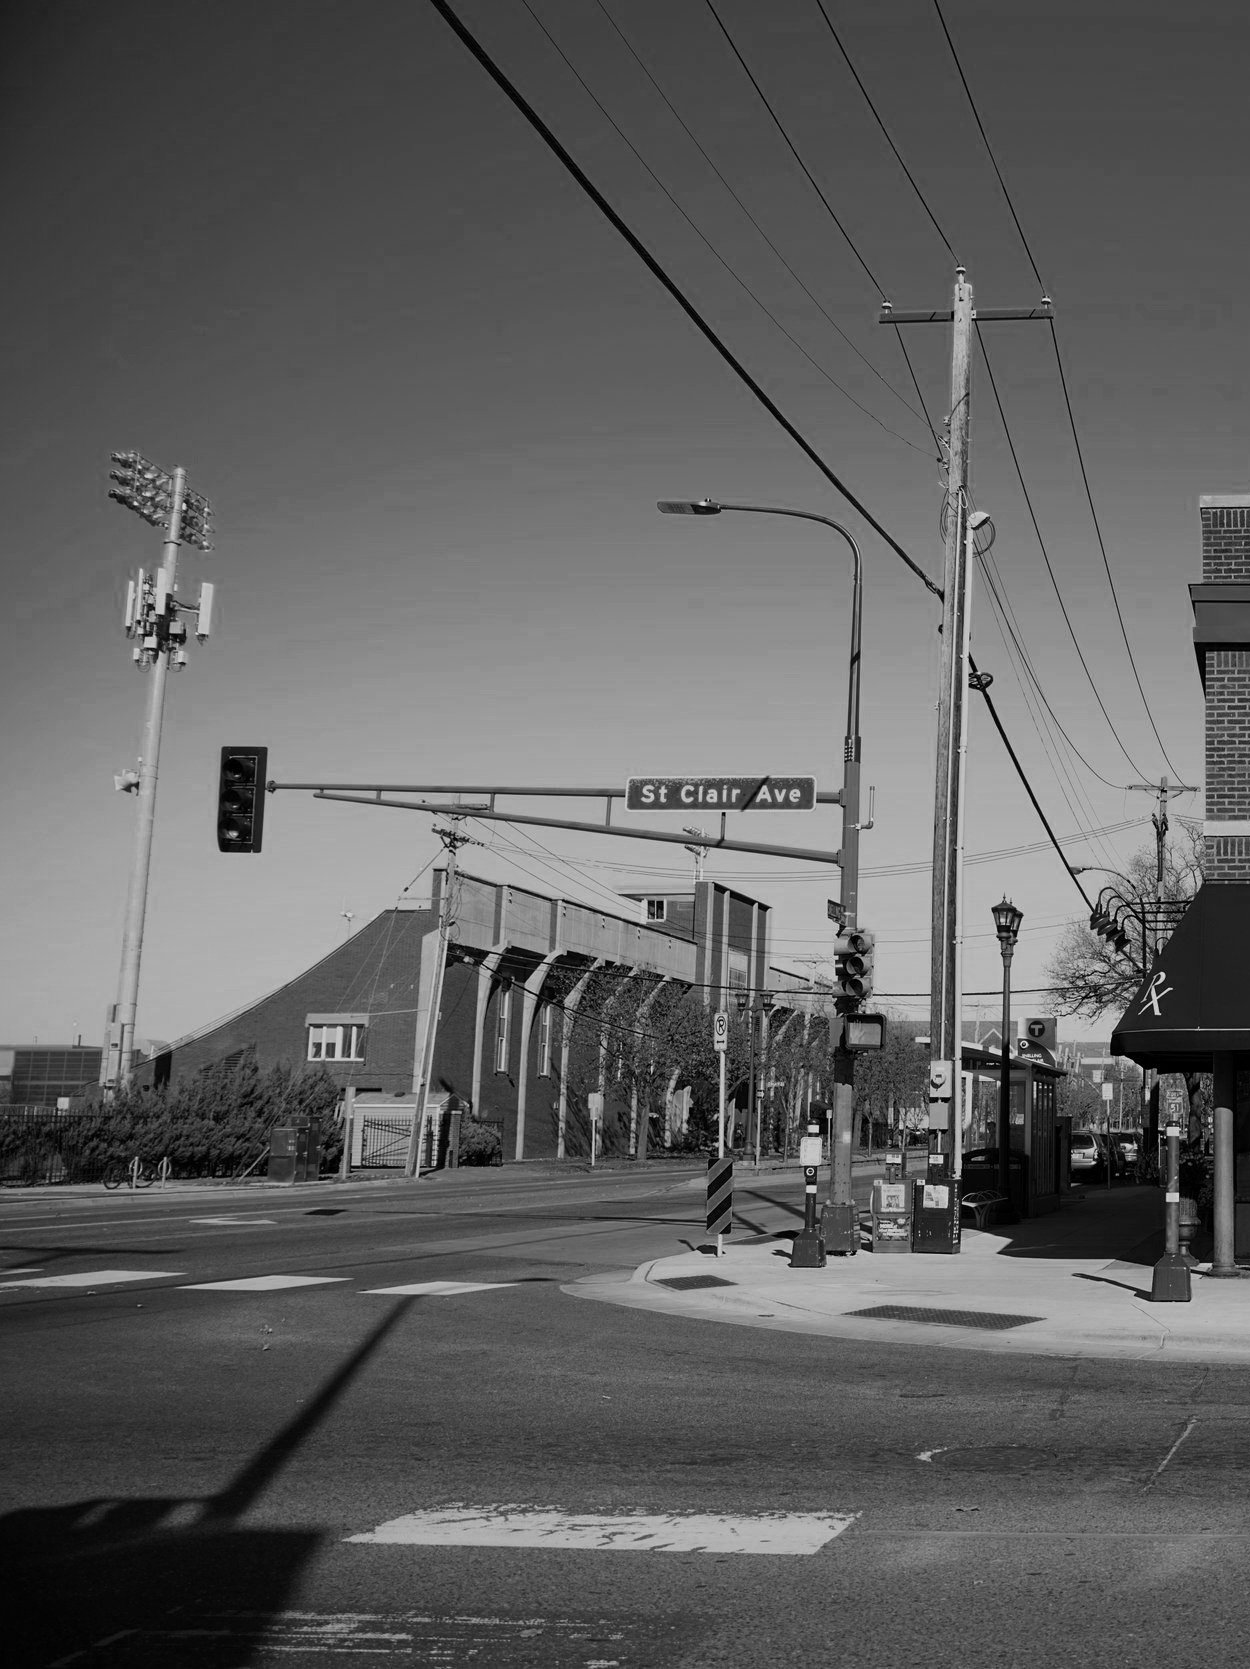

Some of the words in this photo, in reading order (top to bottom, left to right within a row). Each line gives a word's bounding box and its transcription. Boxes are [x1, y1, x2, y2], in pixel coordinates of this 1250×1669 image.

[640, 784, 668, 803] St
[680, 784, 742, 804] Clair
[755, 784, 802, 804] Ave
